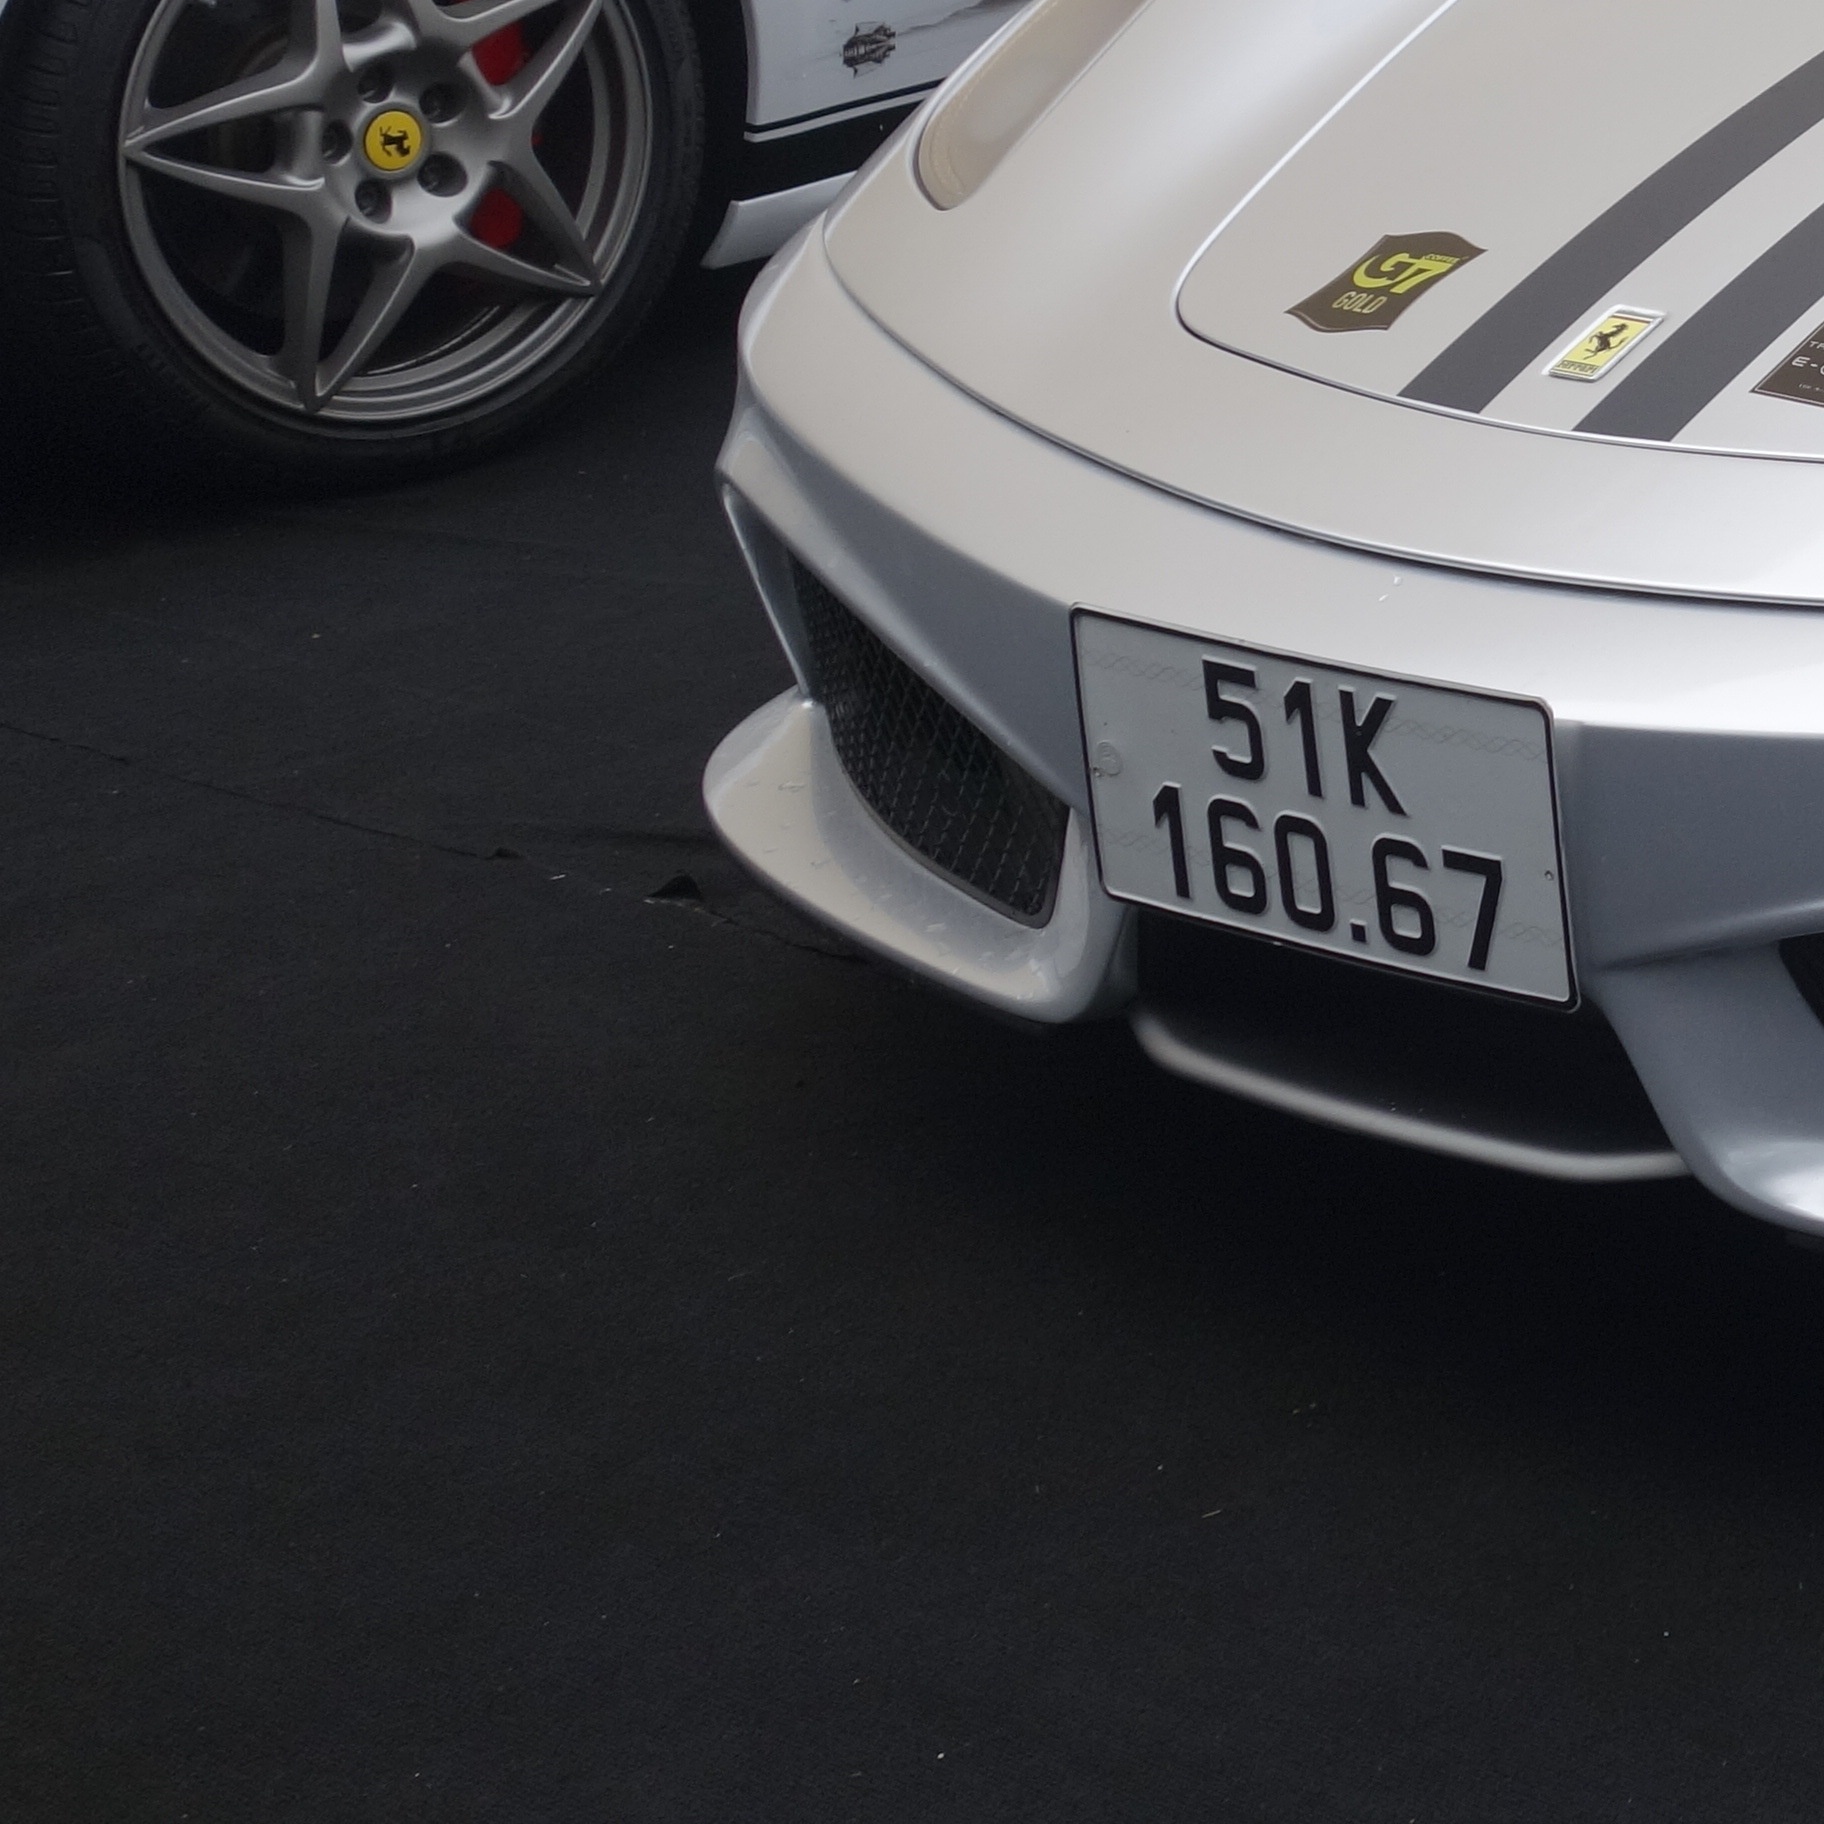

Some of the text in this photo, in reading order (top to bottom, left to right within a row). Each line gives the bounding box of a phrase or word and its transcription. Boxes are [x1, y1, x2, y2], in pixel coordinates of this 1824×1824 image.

[1331, 290, 1388, 314] GOLD
[1201, 654, 1410, 818] 51K
[1151, 781, 1503, 973] 160.67
